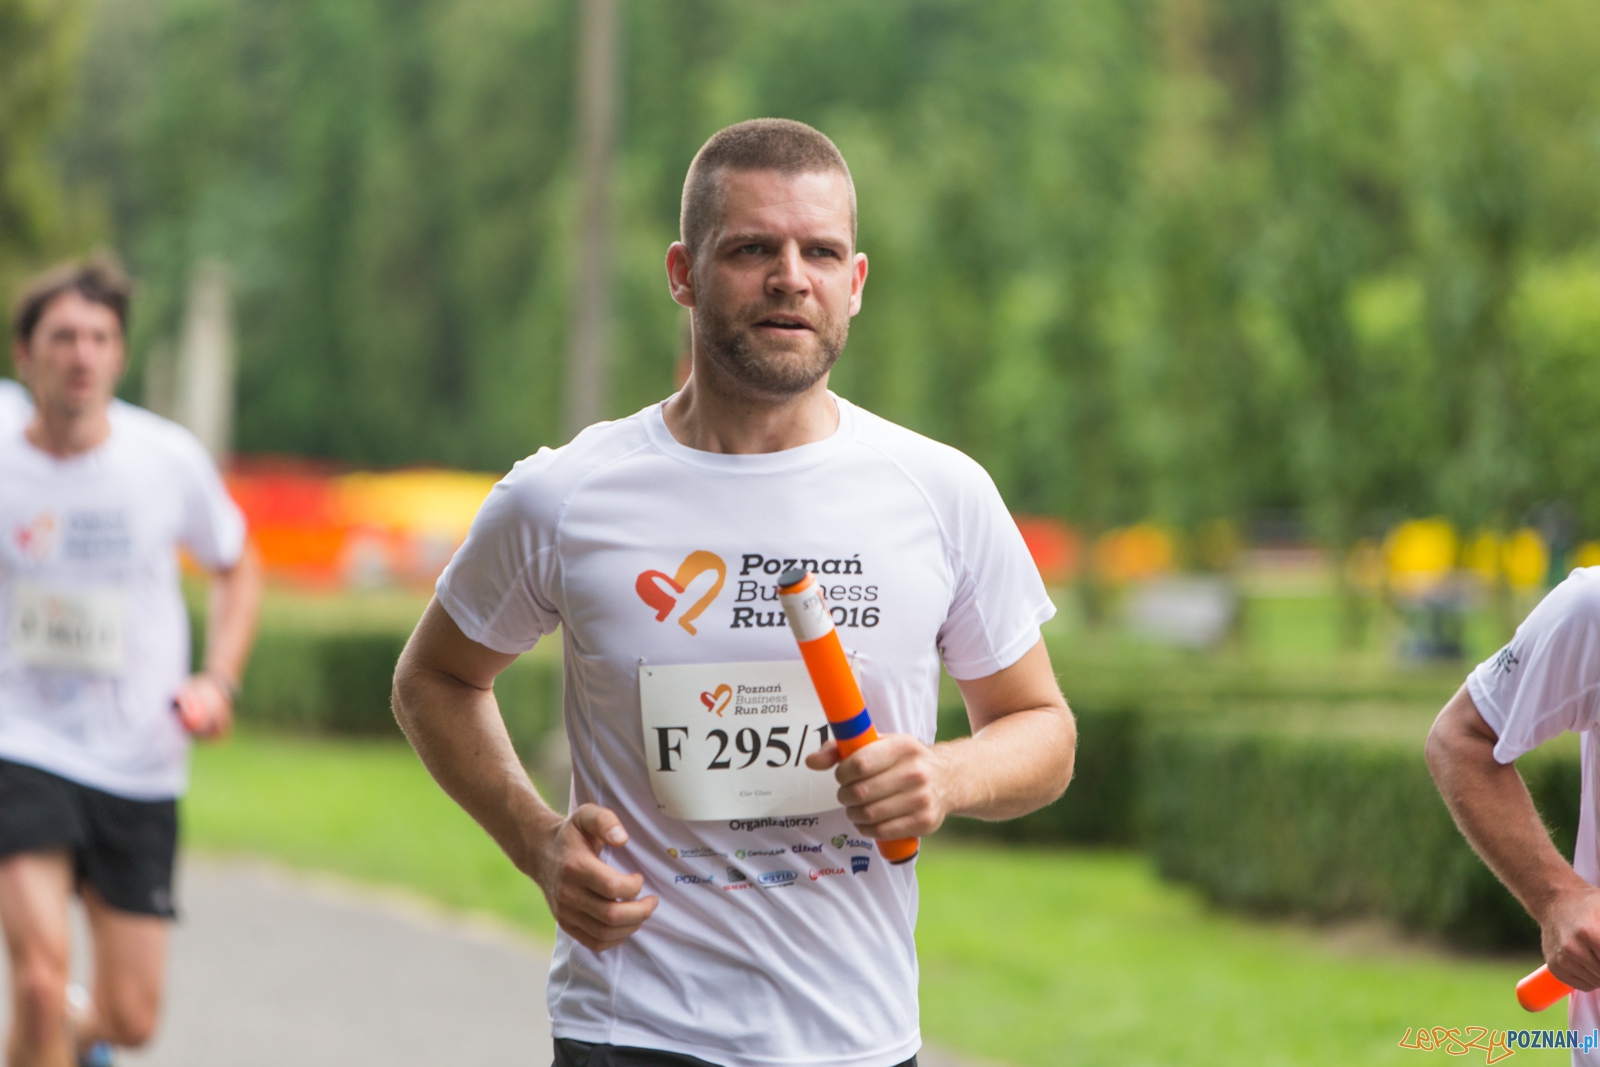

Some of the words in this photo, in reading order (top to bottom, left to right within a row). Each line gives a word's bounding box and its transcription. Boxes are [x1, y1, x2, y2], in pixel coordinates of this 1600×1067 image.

[739, 553, 864, 577] Poznań
[830, 606, 881, 629] 016
[737, 683, 782, 694] Poznań
[735, 695, 788, 705] Business
[734, 706, 759, 715] Run
[760, 704, 788, 714] 2016
[651, 726, 689, 772] F
[729, 816, 819, 832] Organizatorzy:
